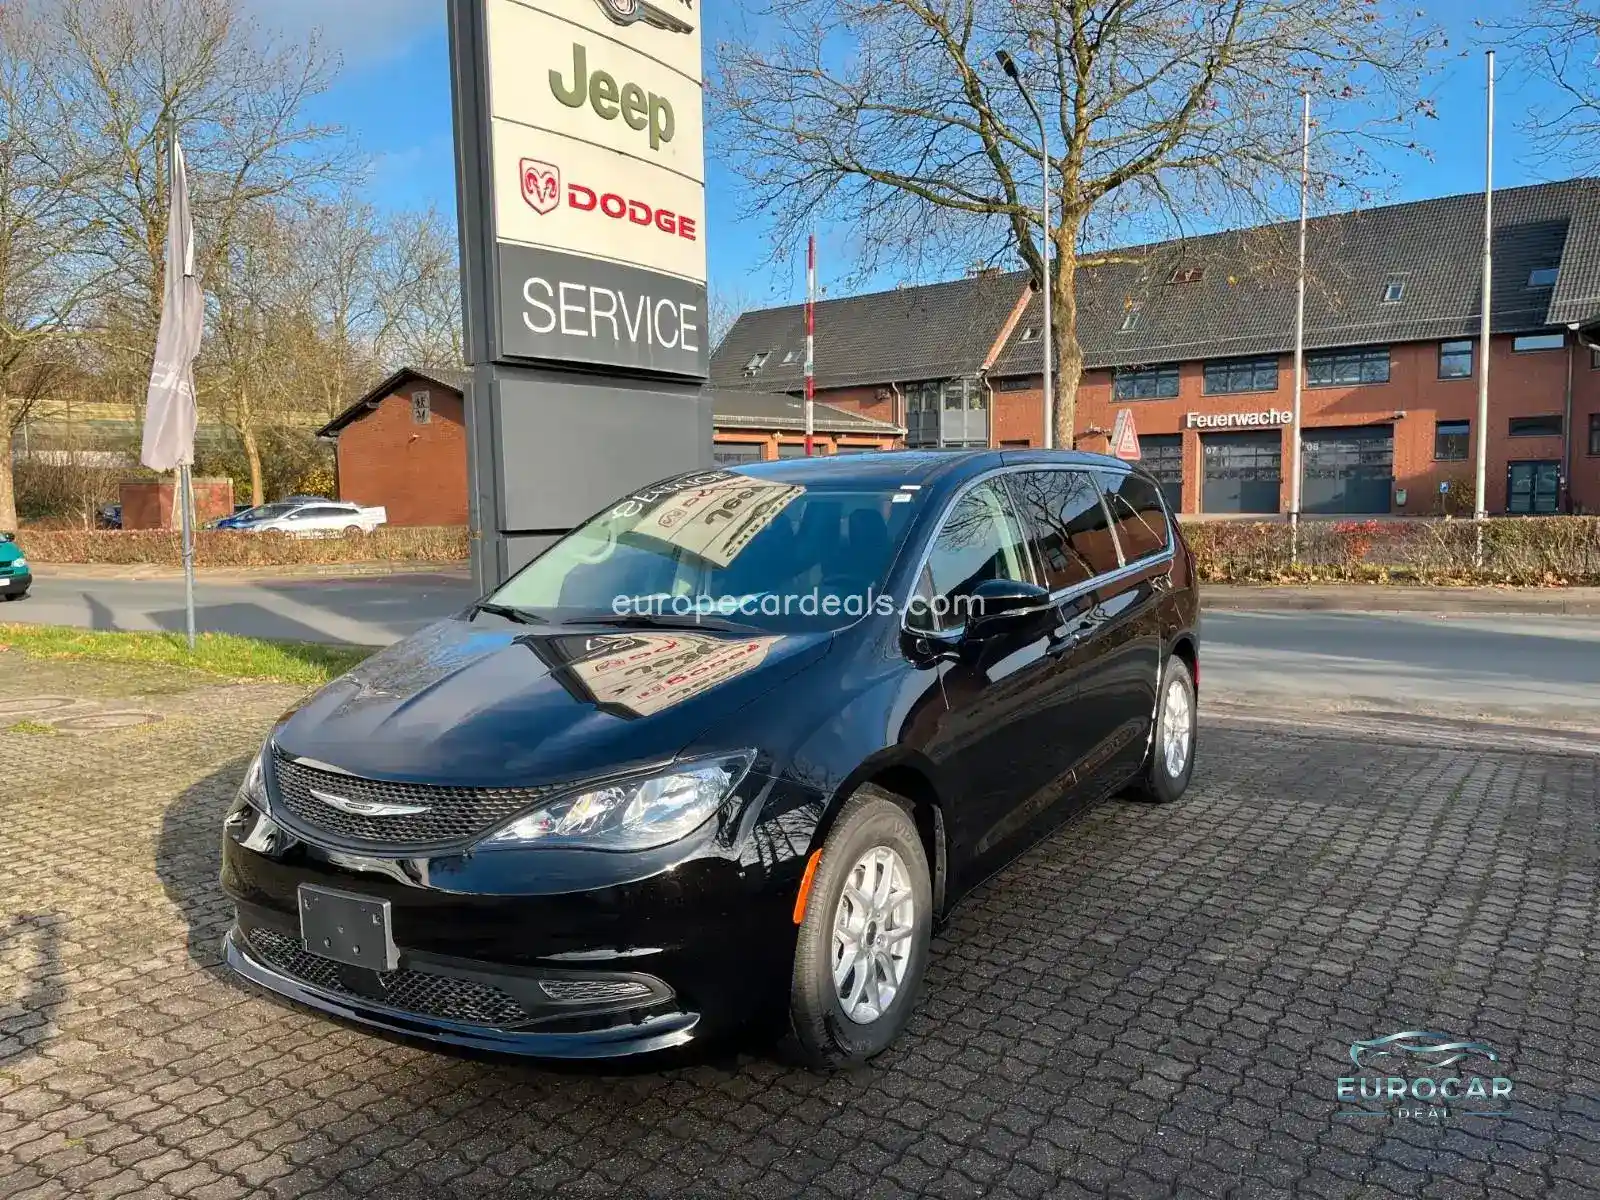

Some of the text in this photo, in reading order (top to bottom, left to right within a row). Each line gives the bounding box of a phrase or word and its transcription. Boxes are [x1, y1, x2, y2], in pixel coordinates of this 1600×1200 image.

[548, 42, 675, 151] Jeep
[567, 183, 697, 241] DODGE
[522, 277, 699, 352] SERVICE
[1186, 408, 1294, 428] Feuerwache
